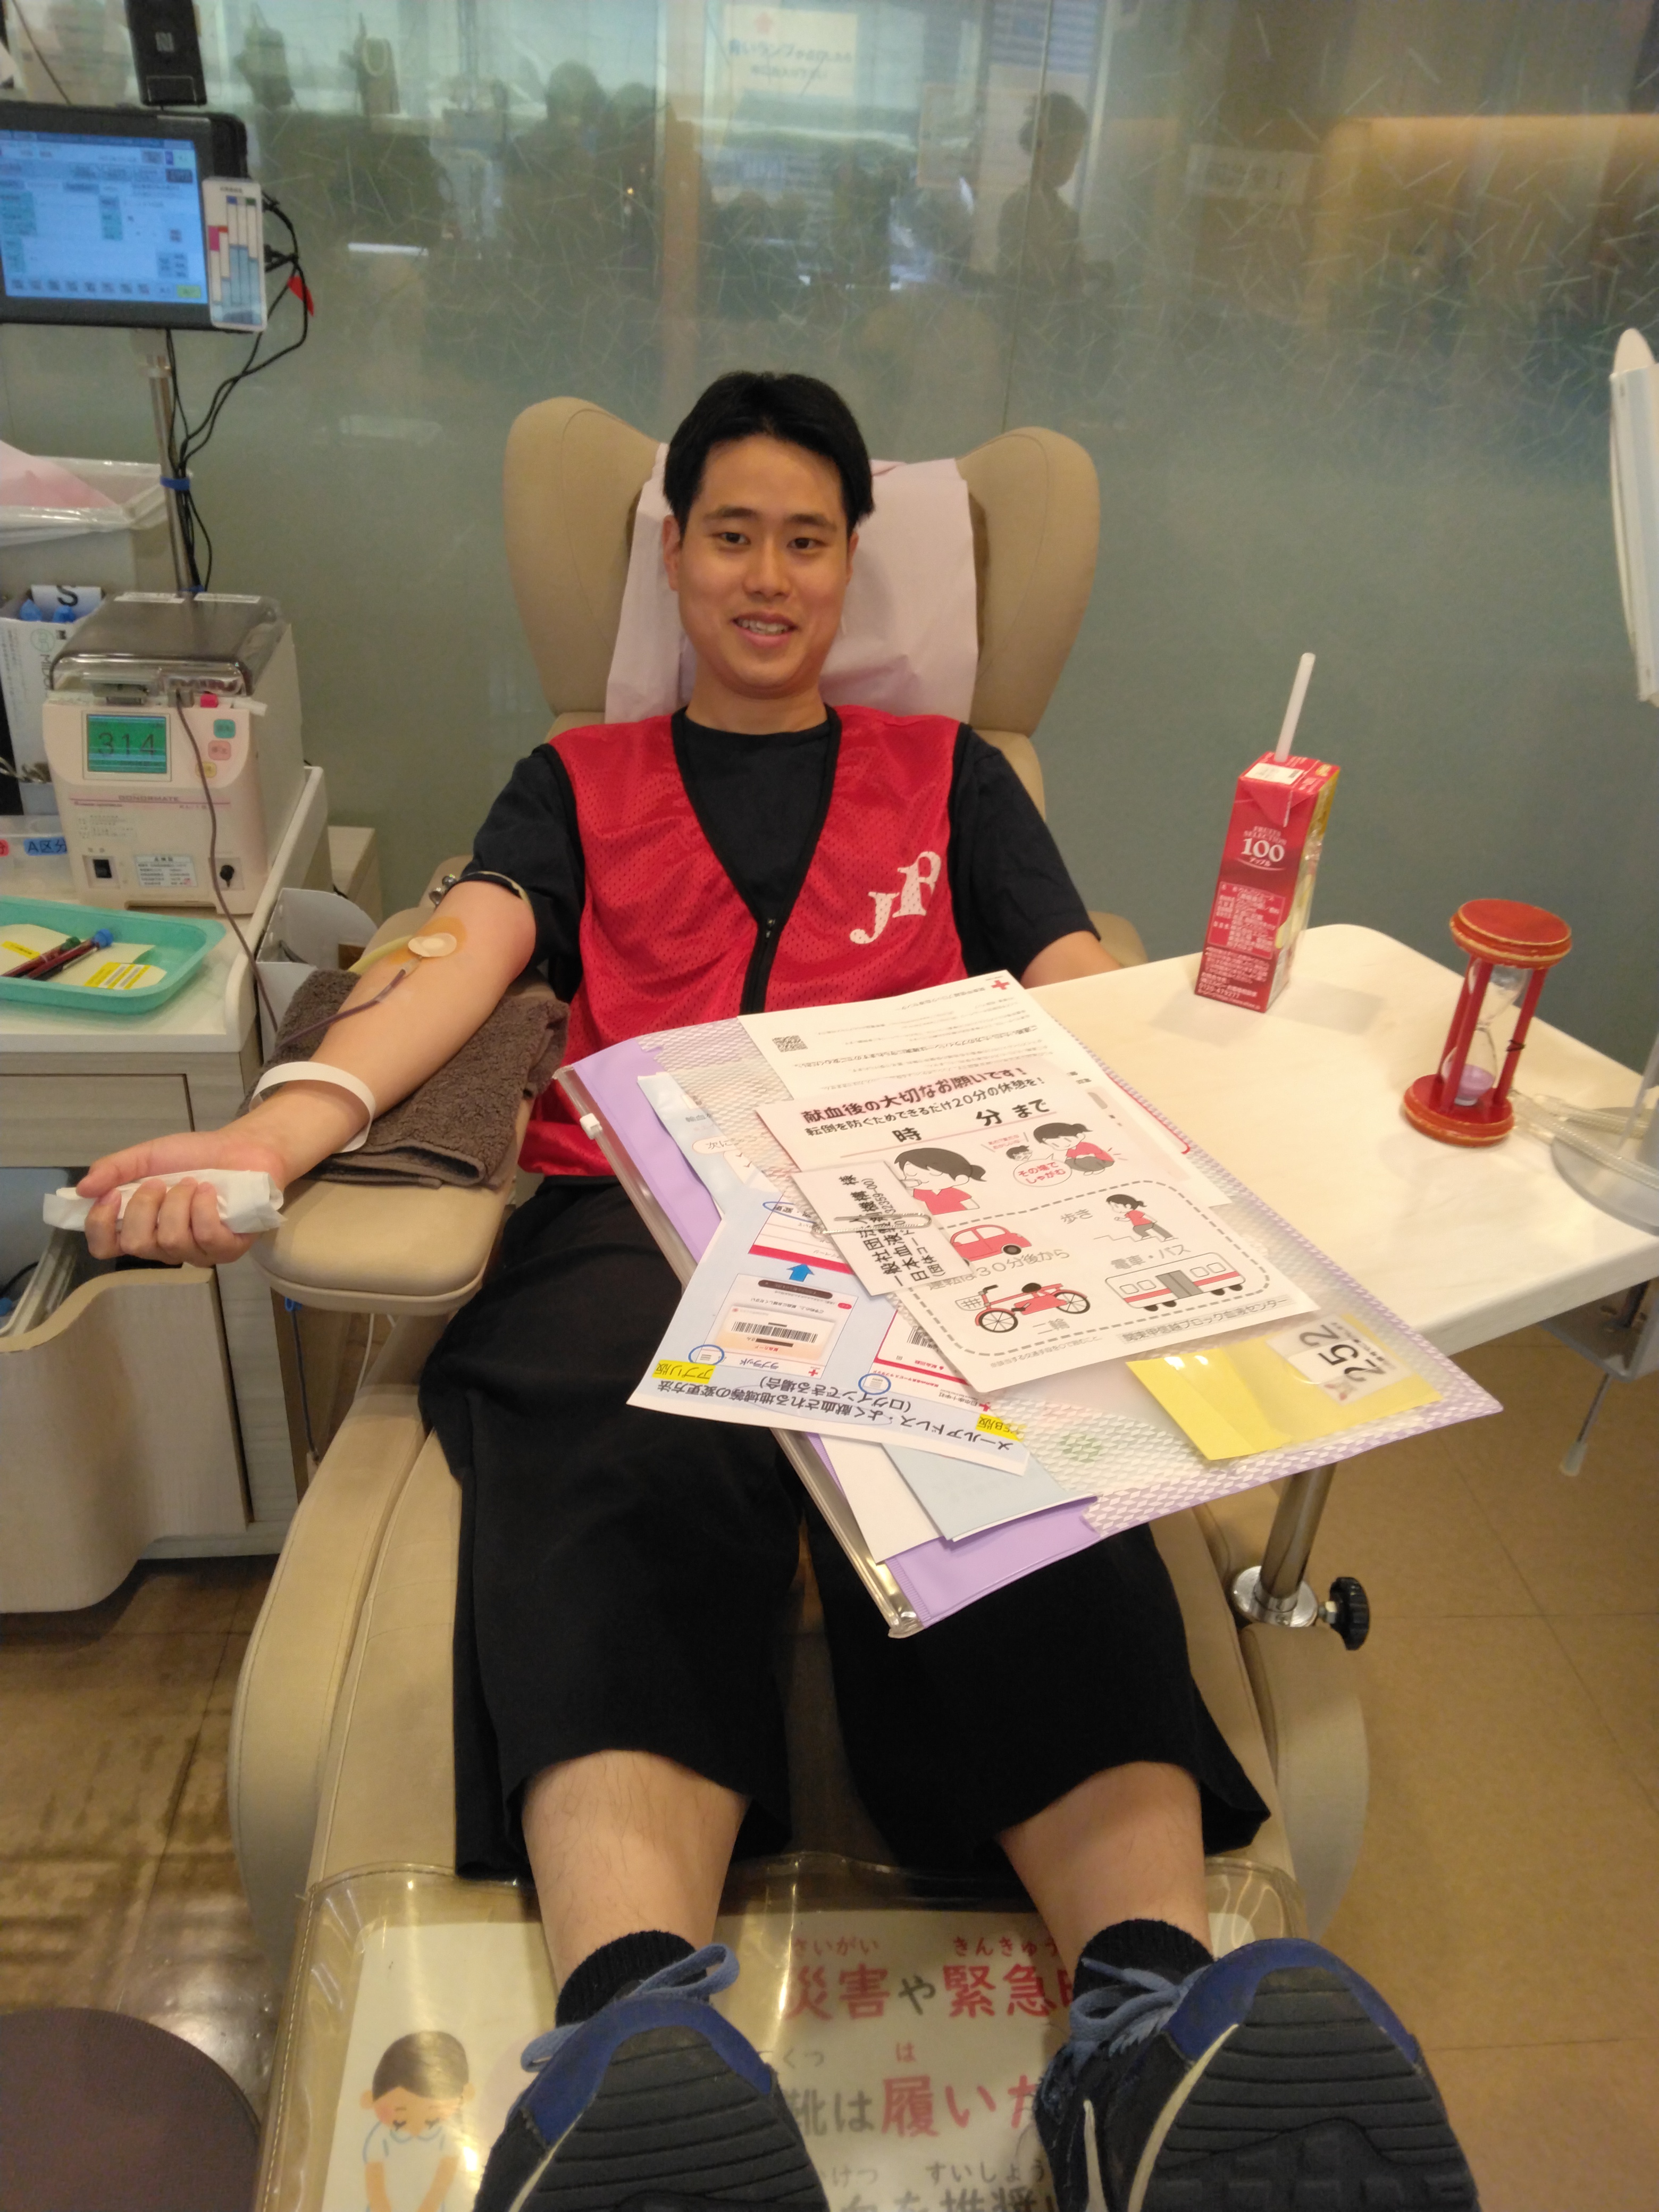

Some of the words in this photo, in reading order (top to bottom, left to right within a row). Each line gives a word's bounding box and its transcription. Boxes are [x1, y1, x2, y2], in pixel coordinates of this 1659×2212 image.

[98, 732, 156, 756] 314
[1241, 837, 1285, 862] 100
[892, 1127, 923, 1143] 時
[976, 1108, 1003, 1127] 分
[1011, 1098, 1051, 1119] まで
[1018, 1161, 1059, 1177] その場で
[1025, 1168, 1066, 1184] しゃがむ
[1060, 1208, 1094, 1225] 歩き
[1111, 1243, 1192, 1270] 電車・バス
[1032, 1319, 1070, 1336] 二輪
[740, 1358, 780, 1370] ラブラッド
[1298, 1324, 1387, 1382] 252
[656, 1363, 714, 1380] アプリ版
[657, 1380, 1013, 1451] メールアドレス・よく献血される地域等の変更方法
[792, 1936, 879, 1957] さいがい
[783, 2048, 825, 2069] くつ
[895, 2041, 917, 2063] は
